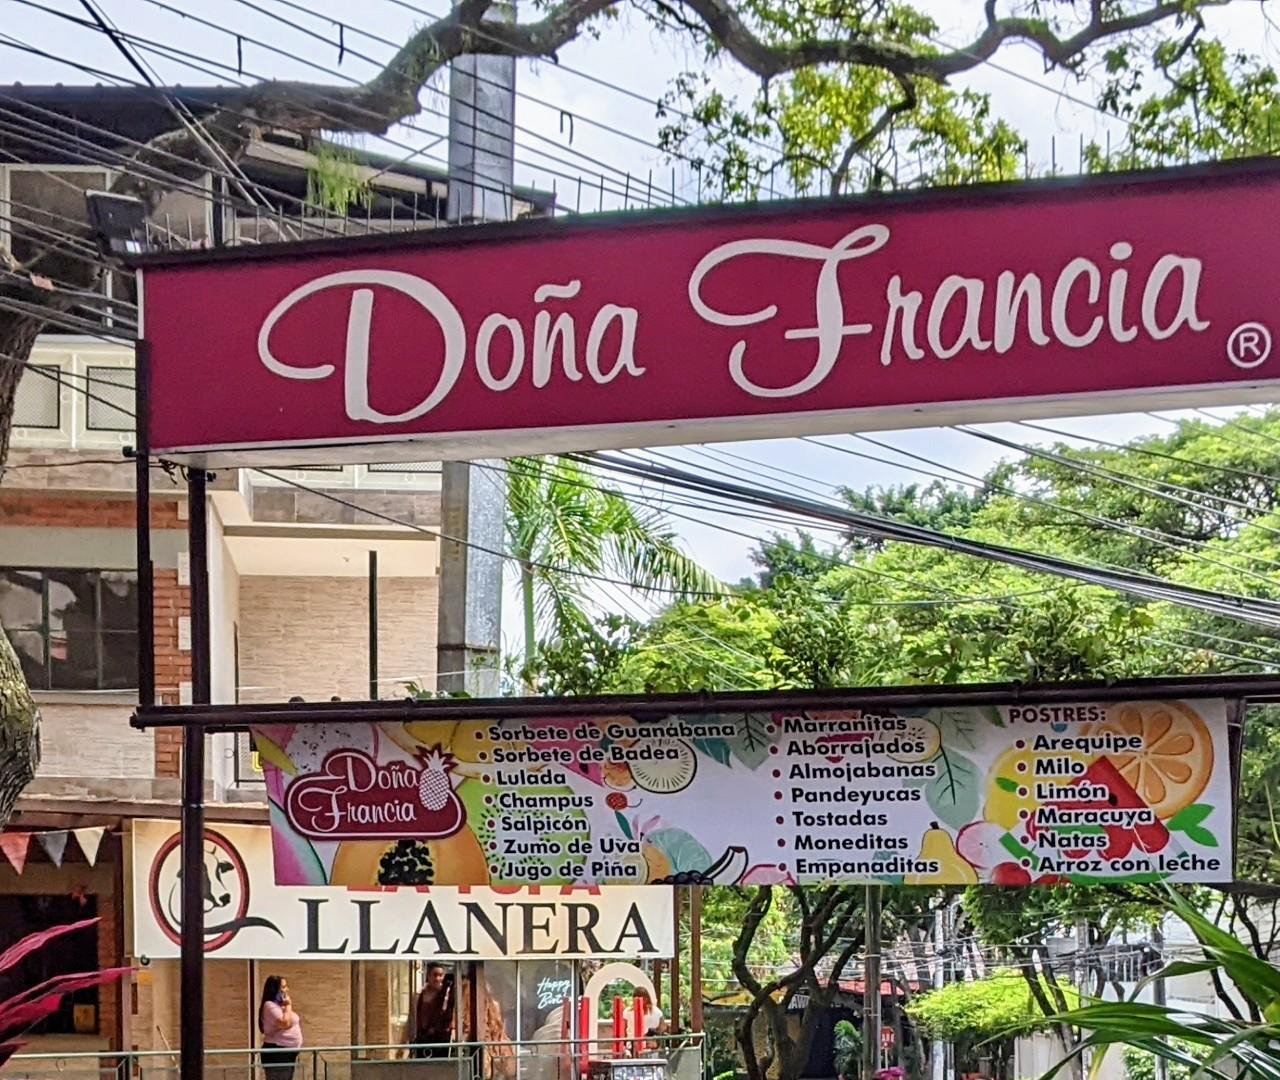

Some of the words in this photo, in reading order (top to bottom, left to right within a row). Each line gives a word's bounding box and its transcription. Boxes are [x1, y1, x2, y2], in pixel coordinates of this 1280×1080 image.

[257, 268, 646, 424] Doña
[688, 223, 1210, 398] Francia
[784, 715, 907, 733] Marranitas
[1008, 706, 1107, 724] POSTRES:
[488, 726, 567, 741] Sorbete
[574, 722, 600, 740] de
[787, 738, 926, 759] Aborrajados
[1033, 733, 1142, 752] Arequipe
[493, 747, 571, 763] Sorbete
[579, 744, 604, 761] de
[611, 744, 679, 761] Badea
[325, 751, 420, 792] Doña
[789, 762, 936, 782] Almojabanas
[1035, 757, 1085, 775] Milo
[497, 769, 566, 785] Lulada
[791, 786, 921, 806] Pandeyucas
[1036, 781, 1107, 799] Limón
[298, 785, 417, 832] Francia
[499, 792, 594, 811] Champus
[501, 815, 587, 834] Salpicón
[792, 810, 888, 826] Tostadas
[1037, 808, 1152, 827] Maracuya
[504, 839, 561, 854] Zumo
[567, 838, 593, 853] de
[600, 838, 640, 853] Uva
[794, 833, 908, 850] Moneditas
[1038, 833, 1107, 848] Natas
[504, 861, 552, 880] Jugo
[559, 861, 584, 876] de
[592, 861, 637, 876] Piña
[796, 857, 939, 877] Empanaditas
[1038, 857, 1103, 872] Arroz
[1110, 858, 1150, 871] con
[1159, 854, 1221, 871] leche
[298, 898, 660, 956] LLANERA
[537, 977, 571, 996] Happy
